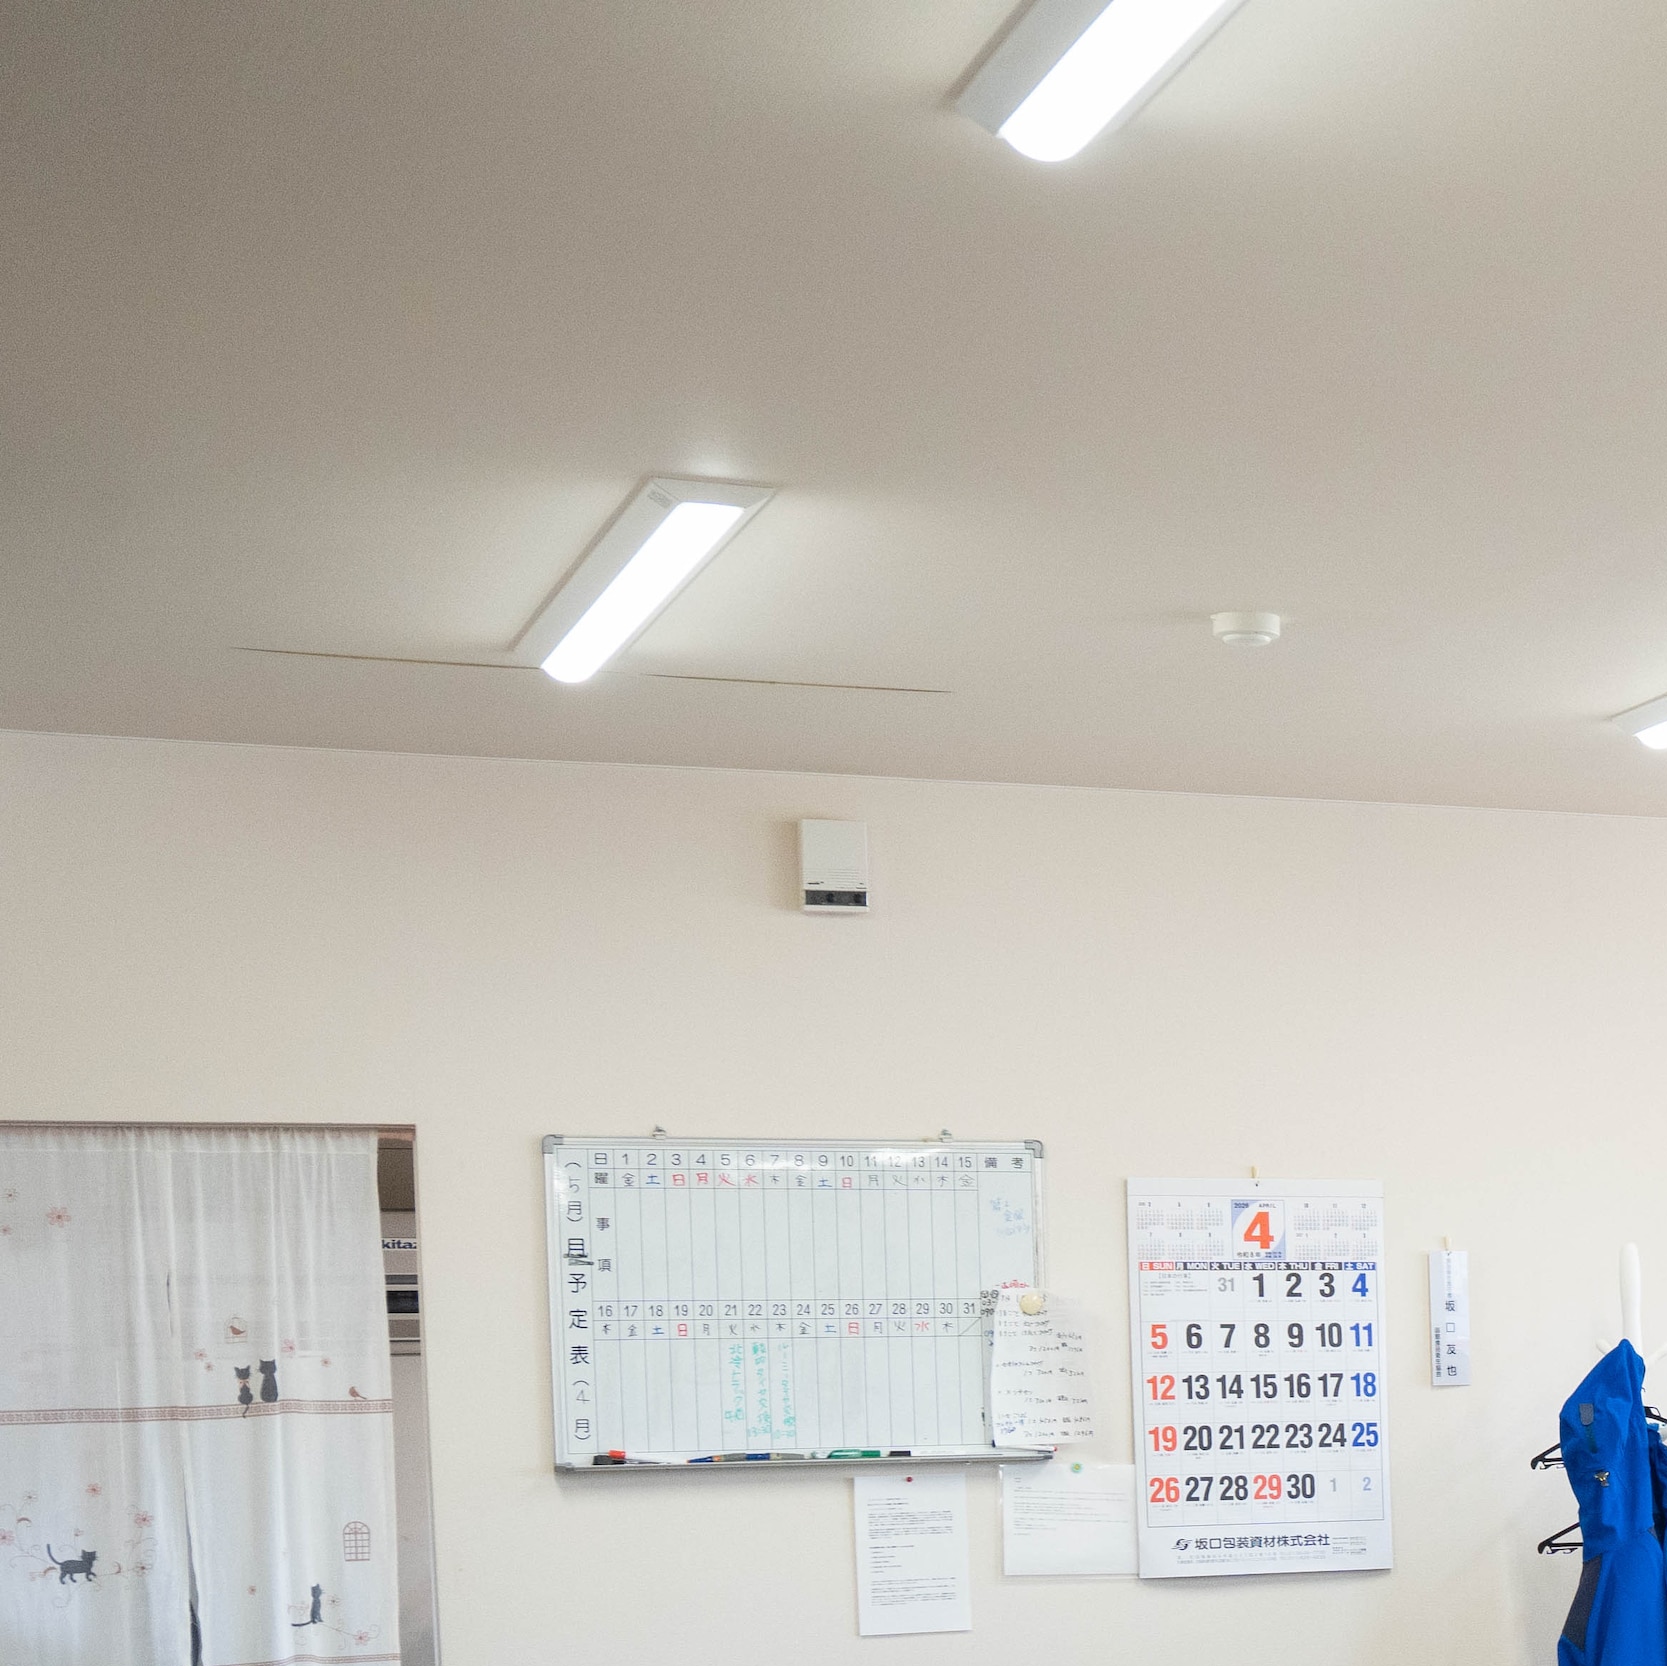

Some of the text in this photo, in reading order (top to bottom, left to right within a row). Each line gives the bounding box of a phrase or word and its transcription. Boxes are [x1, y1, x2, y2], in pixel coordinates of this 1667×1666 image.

[595, 1153, 607, 1165] 日
[622, 1154, 629, 1165] 1
[647, 1153, 657, 1165] 2
[671, 1154, 681, 1165] 3
[696, 1154, 706, 1165] 4
[721, 1154, 731, 1166] 5
[745, 1154, 755, 1166] 6
[794, 1155, 804, 1166] 8
[818, 1154, 828, 1166] 9
[840, 1156, 854, 1167] 10
[912, 1156, 925, 1168] 13
[935, 1156, 948, 1168] 14
[959, 1157, 972, 1168] 15
[646, 1175, 660, 1185] 土
[672, 1174, 685, 1186] 日
[697, 1173, 708, 1184] 月
[819, 1179, 832, 1187] 土
[842, 1177, 852, 1188] 日
[1243, 1211, 1275, 1249] 4
[1345, 1262, 1354, 1270] 土
[1217, 1277, 1236, 1293] 31
[1252, 1273, 1265, 1298] 1
[1285, 1273, 1302, 1298] 2
[1318, 1272, 1335, 1297] 3
[1352, 1272, 1369, 1297] 4
[598, 1305, 613, 1317] 16
[624, 1306, 638, 1317] 17
[650, 1305, 663, 1317] 18
[675, 1305, 688, 1317] 19
[700, 1304, 713, 1316] 20
[724, 1304, 738, 1316] 21
[748, 1304, 762, 1316] 22
[773, 1304, 786, 1316] 23
[797, 1304, 810, 1315] 24
[821, 1304, 835, 1315] 25
[845, 1304, 859, 1315] 26
[869, 1304, 883, 1315] 27
[892, 1304, 906, 1315] 28
[916, 1303, 929, 1314] 29
[939, 1303, 953, 1314] 30
[963, 1303, 975, 1314] 31
[652, 1326, 665, 1335] 土
[678, 1324, 688, 1336] 日
[824, 1325, 837, 1334] 土
[848, 1322, 859, 1335] 日
[1151, 1322, 1374, 1350] 5 6 7 8 9 10 11
[1146, 1372, 1376, 1401] 12 13 14 15 16 17 18
[1148, 1422, 1379, 1452] 19 20 21 22 23 24 25
[1150, 1473, 1372, 1503] 26 27 28 29 30 1 2
[1195, 1534, 1330, 1550] 坂口包装資材株式会社
